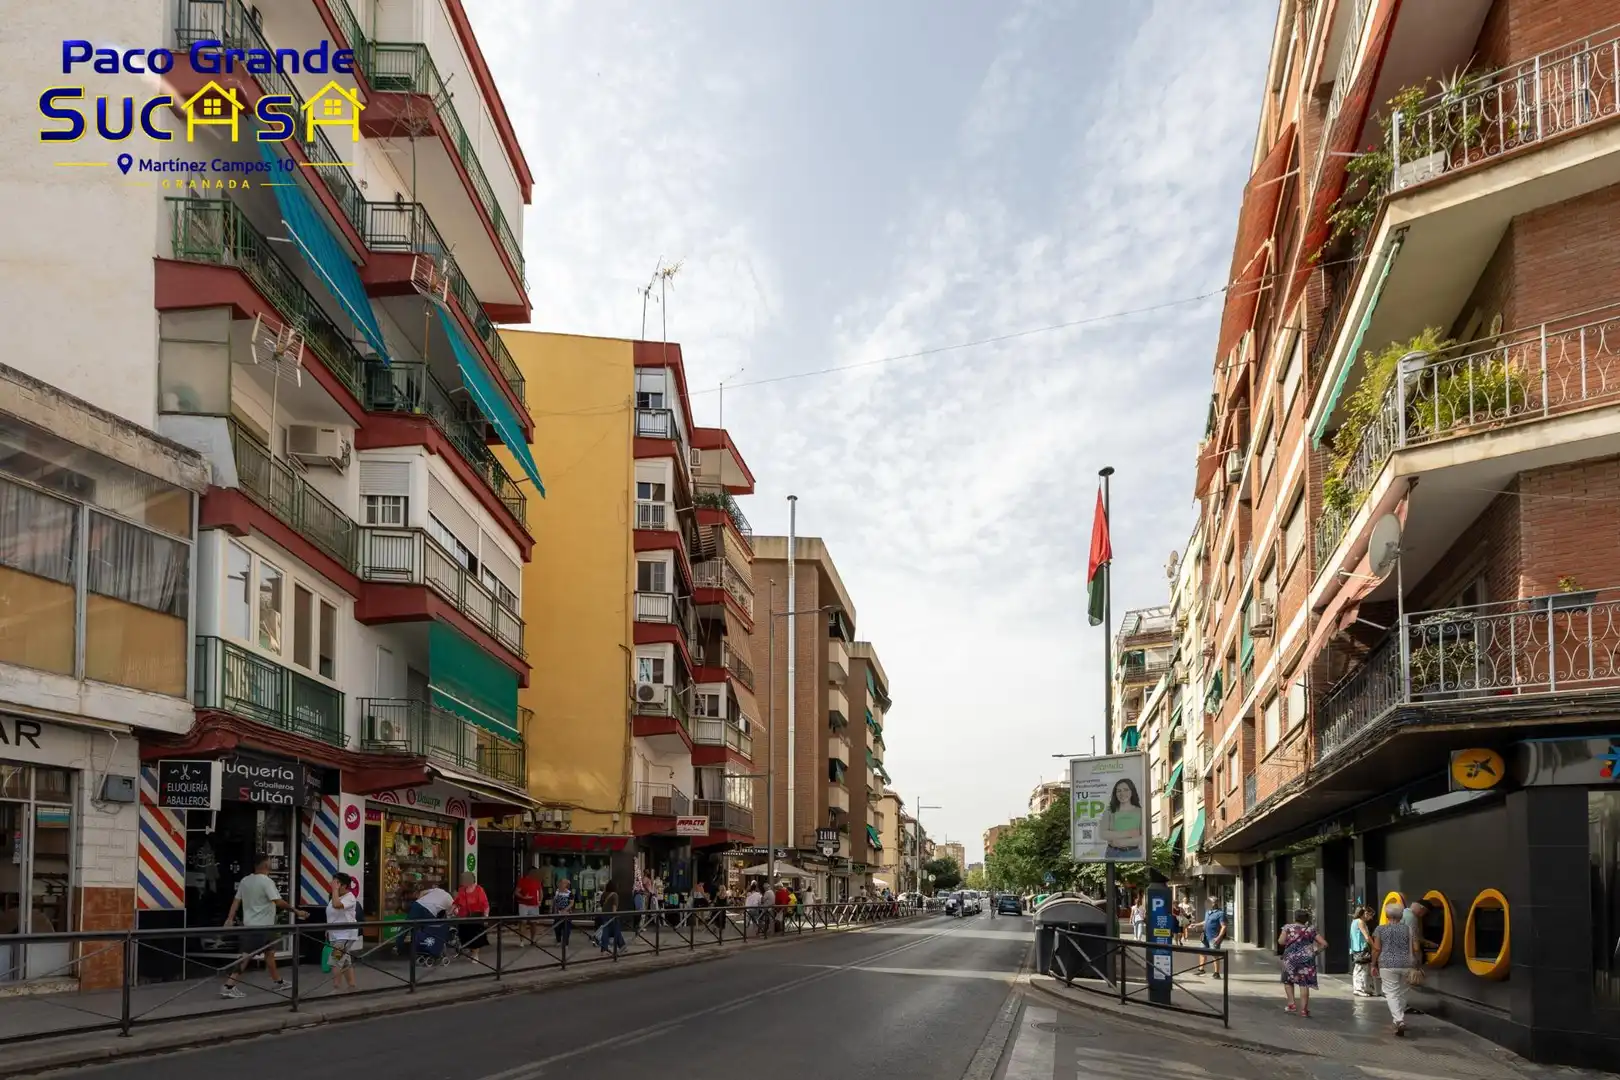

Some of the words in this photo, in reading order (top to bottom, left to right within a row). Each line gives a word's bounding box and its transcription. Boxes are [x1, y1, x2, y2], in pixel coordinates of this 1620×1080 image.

[239, 787, 294, 805] Sultán
[1076, 791, 1089, 799] TU
[1075, 801, 1106, 818] FP
[1152, 898, 1164, 912] P
